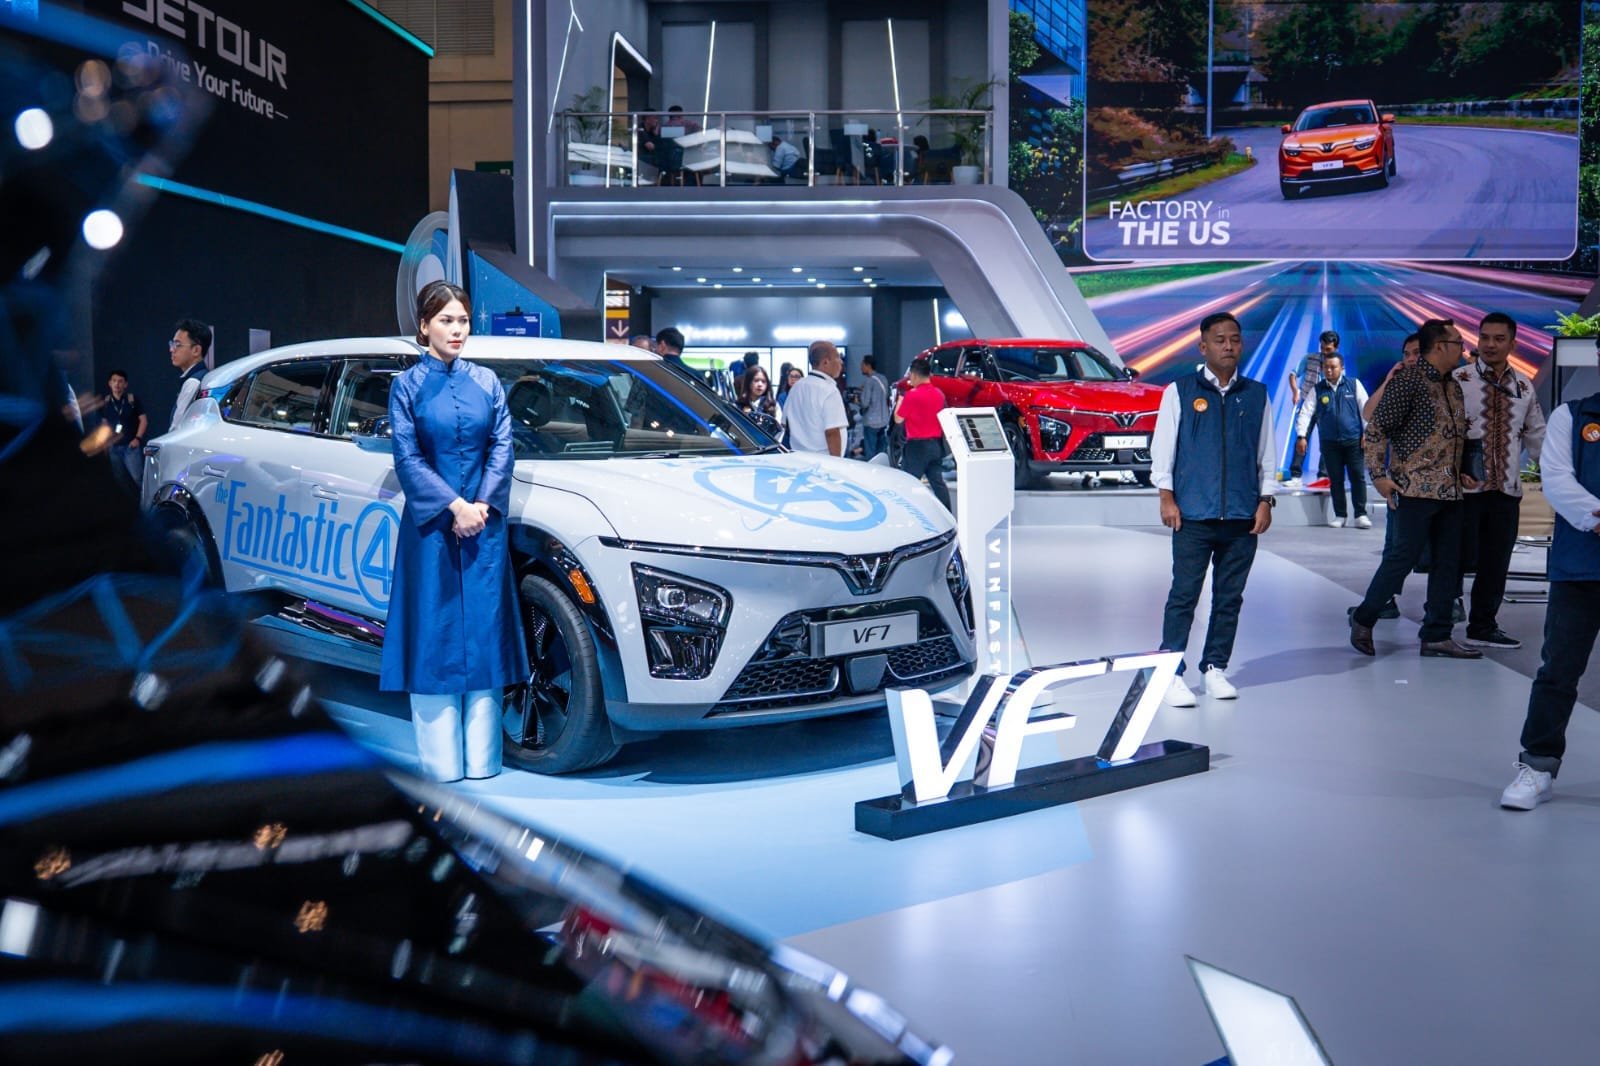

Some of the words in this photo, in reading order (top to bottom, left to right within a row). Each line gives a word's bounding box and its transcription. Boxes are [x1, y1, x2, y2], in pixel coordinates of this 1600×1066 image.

[193, 61, 229, 99] Your
[1108, 200, 1214, 220] FACTORY
[1217, 206, 1230, 219] in
[1117, 221, 1180, 246] THE
[1188, 220, 1231, 246] US
[223, 480, 353, 581] Fantastic
[987, 537, 1001, 676] VINFAST
[852, 624, 891, 644] VF7
[885, 650, 1185, 803] VF7
